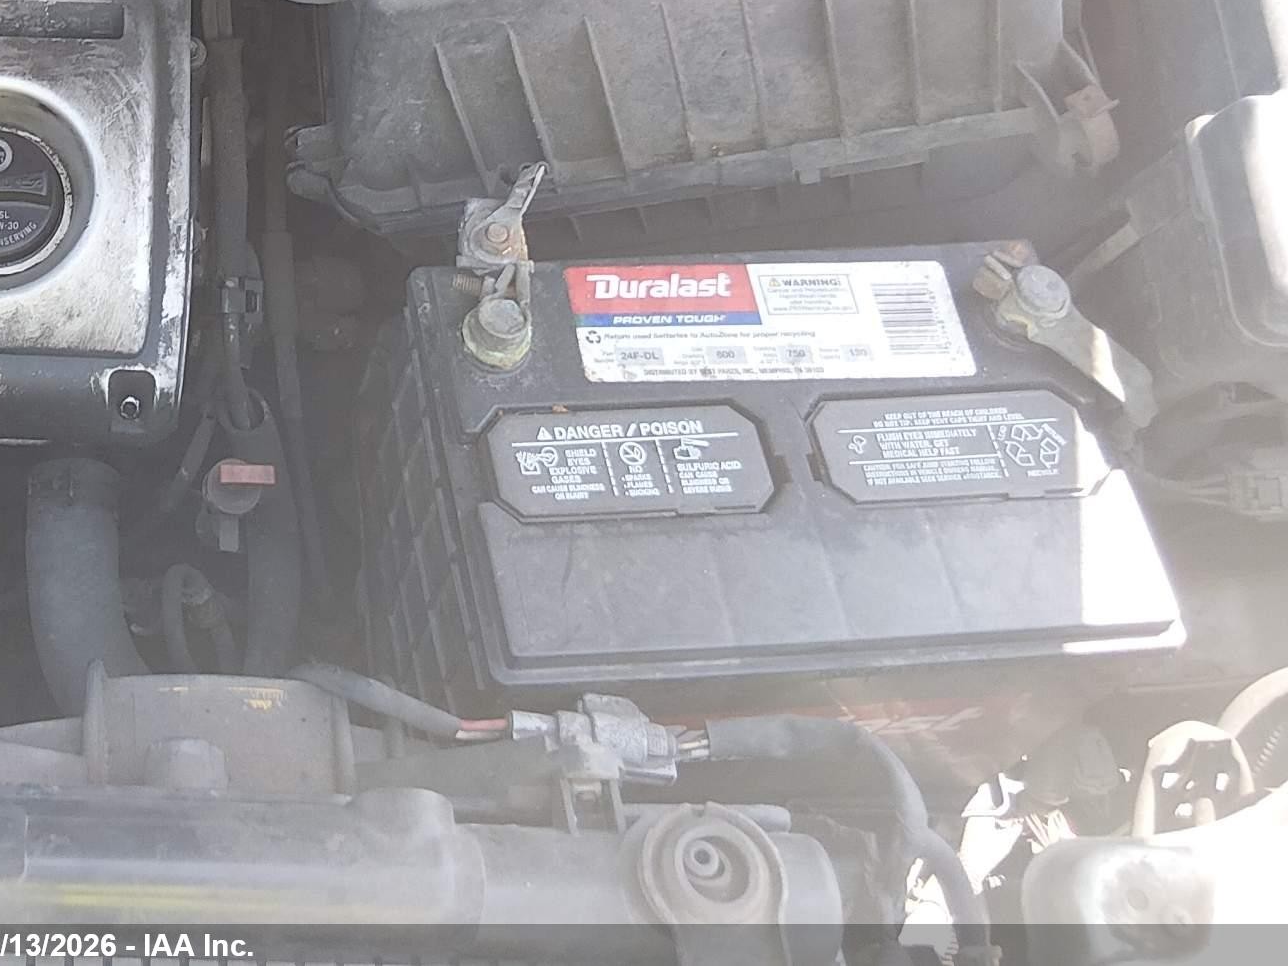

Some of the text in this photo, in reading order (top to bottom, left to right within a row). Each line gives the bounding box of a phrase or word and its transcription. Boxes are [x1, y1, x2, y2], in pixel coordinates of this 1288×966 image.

[585, 272, 732, 299] Duralast
[613, 314, 727, 325] PROVEN TOUGH
[620, 351, 660, 361] 24F-DL
[553, 424, 624, 441] DANGER
[639, 420, 704, 436] POISON
[876, 432, 904, 442] FLUSH
[924, 428, 977, 440] IMMEDIATELY
[879, 441, 902, 450] WITH
[564, 448, 597, 458] SHIELD
[882, 446, 961, 458] MEDICAL HELP FAST
[567, 457, 592, 466] EYES
[676, 460, 742, 472] SULFURIC ACID
[548, 465, 598, 475] EXPLOSIVE
[628, 465, 643, 473] NO
[551, 474, 582, 484] GASES
